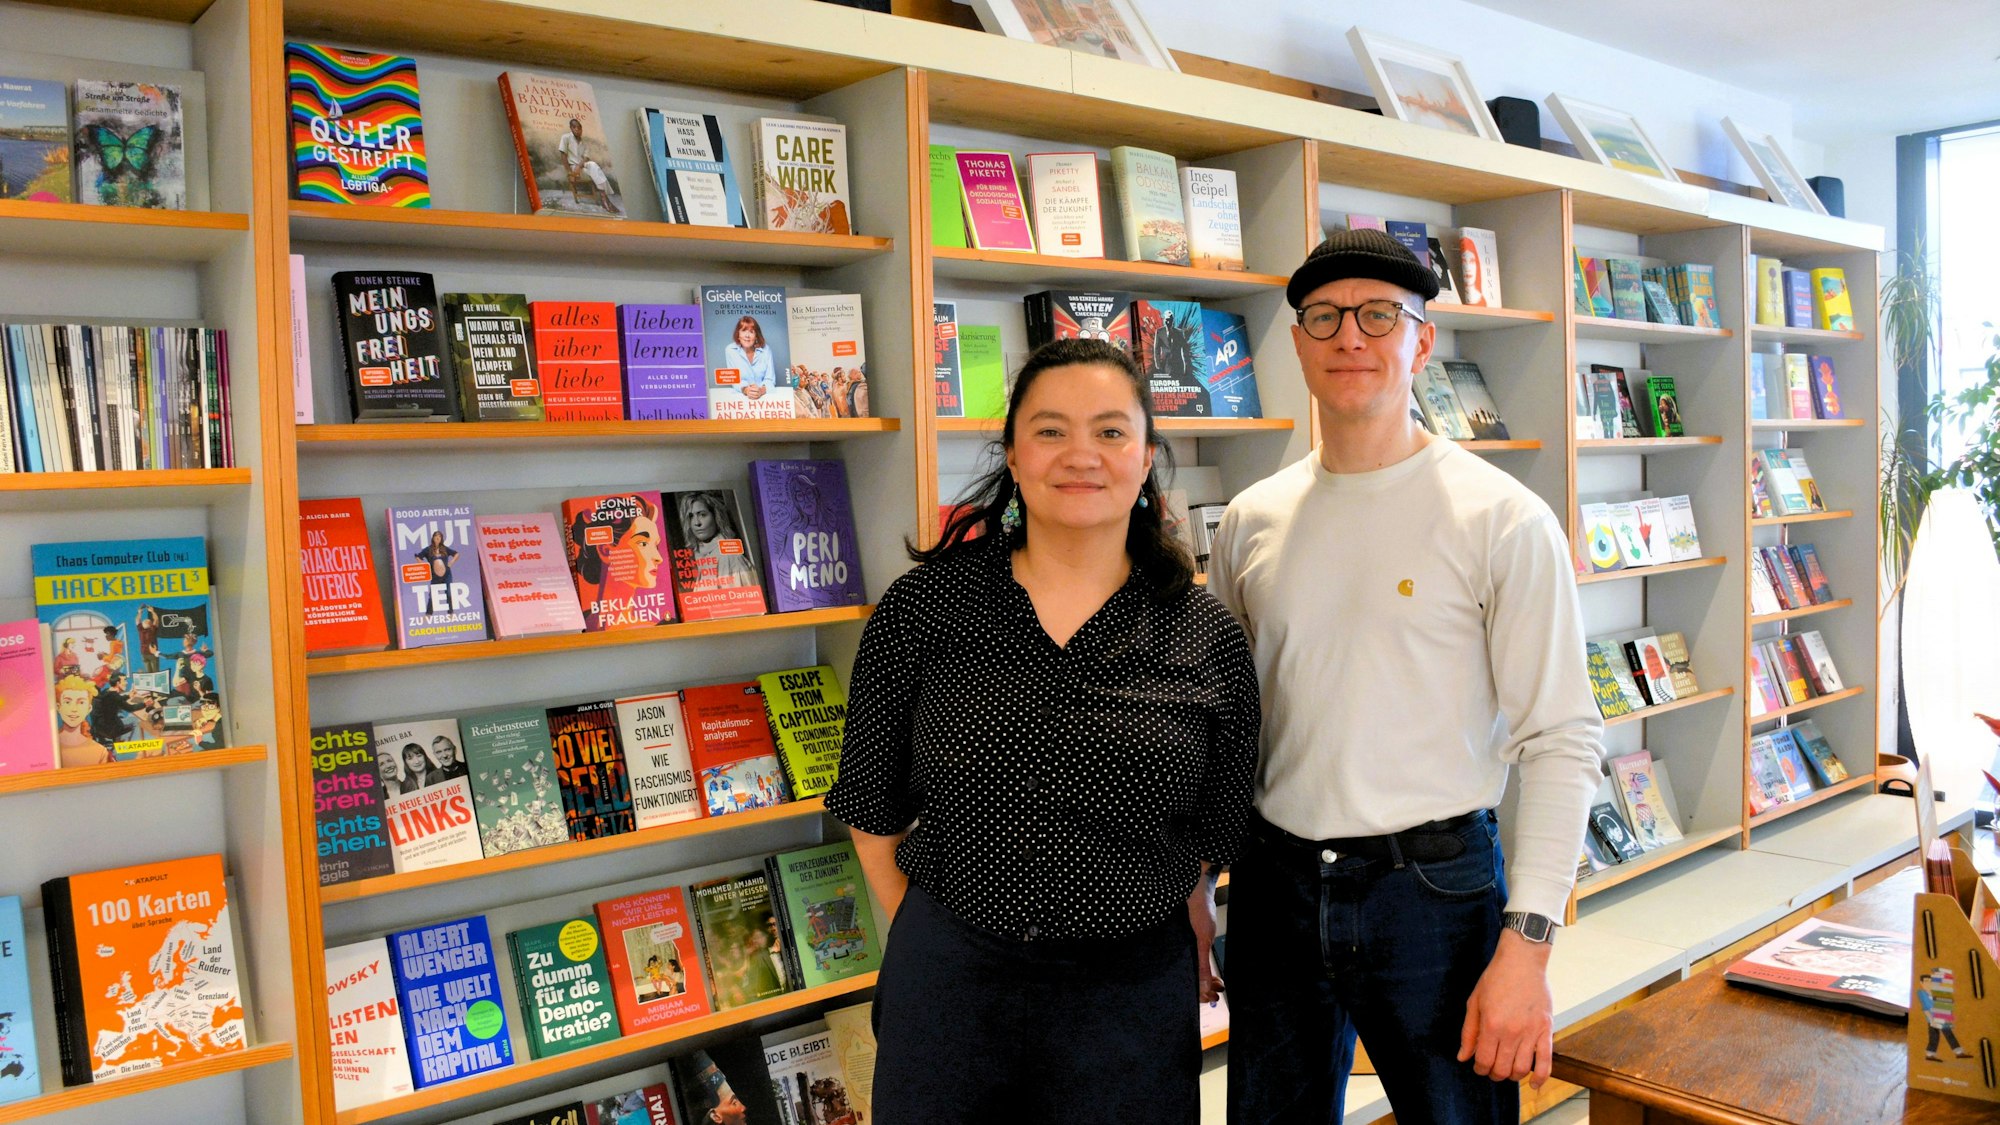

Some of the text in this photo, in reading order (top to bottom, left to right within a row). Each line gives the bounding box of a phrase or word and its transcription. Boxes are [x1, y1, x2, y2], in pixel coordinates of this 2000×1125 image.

[85, 92, 151, 104] Straße Straße
[524, 84, 566, 98] JAMES
[518, 93, 593, 112] BALDWIN
[86, 105, 168, 117] Gesammelte Gedichte
[529, 105, 586, 121] Der Zeuge
[666, 117, 700, 126] ZWISCHEN
[310, 116, 414, 152] QUEER
[678, 128, 694, 136] HASS
[677, 148, 706, 157] HALTUNG
[776, 134, 834, 164] CARE
[313, 146, 413, 170] GESTREIFT
[964, 160, 1006, 168] THOMAS
[777, 166, 836, 194] WORK
[969, 169, 1006, 178] PIKETTY
[1190, 170, 1214, 182] Ines
[342, 179, 394, 193] LGBTIQA+
[1136, 176, 1176, 194] ODYSSEE
[1192, 182, 1228, 198] Geipel
[1192, 198, 1237, 210] Landschaft
[1218, 211, 1238, 220] ohne
[1208, 220, 1238, 232] Zeugen
[355, 276, 420, 286] RONEN STEINKE
[706, 289, 782, 304] Gisèle Pelicot
[462, 304, 474, 312] OLE
[1069, 302, 1114, 312] FAKTEN
[550, 306, 600, 327] alles
[634, 310, 694, 330] lieben
[469, 320, 516, 332] WARUM ICH
[471, 333, 524, 344] NIEMALS FÜR
[473, 347, 516, 358] MEIN LAND
[553, 337, 602, 358] über
[634, 340, 698, 359] lernen
[476, 360, 513, 371] KÄMPFEN
[478, 373, 506, 385] WÜRDE
[554, 366, 604, 389] liebe
[716, 400, 791, 410] EINE HYMNE
[594, 496, 636, 510] LEONIE
[396, 506, 470, 518] 8000 ARTEN, ALS
[590, 508, 642, 522] SCHÖLER
[307, 530, 328, 546] DAS
[482, 525, 540, 536] Heute ist
[486, 539, 542, 550] ein guter
[793, 532, 838, 566] PERI
[56, 551, 170, 568] Chaos Computer Club
[489, 552, 542, 564] Tag, das
[674, 549, 693, 558] ICH
[676, 556, 718, 568] KÄMPFE
[678, 568, 719, 579] FÜR DIE
[790, 562, 848, 591] MENO
[306, 572, 362, 601] UTERUS
[497, 580, 532, 590] abzu-
[411, 582, 472, 614] TER
[501, 592, 558, 604] schaffen
[590, 592, 666, 614] BEKLAUTE
[684, 590, 760, 605] Caroline Darian
[308, 610, 356, 618] KÖRPERLICHE
[312, 604, 347, 612] PLÄDOYER
[409, 611, 481, 626] ZU VERSAGEN
[598, 608, 660, 628] FRAUEN
[409, 622, 483, 637] CAROLIN KEBEKUS
[778, 670, 824, 692] ESCAPE
[790, 688, 825, 708] FROM
[577, 704, 592, 712] JUAN
[637, 706, 666, 722] JASON
[472, 719, 540, 736] Reichensteuer
[701, 718, 754, 730] Kapitalismus-
[376, 730, 413, 747] DANIEL BAX
[635, 724, 674, 742] STANLEY
[704, 730, 738, 742] analysen
[652, 753, 670, 768] WIE
[805, 762, 835, 774] LIBERATING
[634, 769, 692, 792] FASCHISMUS
[399, 784, 462, 812] NEUE LUST AUF
[635, 788, 699, 812] FUNKTIONIERT
[387, 796, 472, 847] LINKS
[788, 852, 850, 873] WERKZEUGKASTEN
[800, 864, 844, 882] DER ZUKUNFT
[696, 876, 765, 898] MOHAMED AMJAHID
[714, 884, 768, 902] UNTER WEISSEN
[88, 890, 212, 928] 100 Karten
[612, 901, 632, 911] DAS
[624, 903, 663, 916] WIR UNS
[132, 916, 172, 929] über Sprache
[399, 922, 470, 956] ALBERT
[203, 944, 222, 954] Land
[198, 960, 232, 976] Ruderer
[402, 942, 488, 981] WENGER
[527, 952, 554, 970] Zu
[532, 962, 592, 988] dumm
[198, 992, 229, 1001] Grenzland
[408, 973, 492, 1012] DIE WELT
[535, 978, 600, 1007] für die
[126, 1008, 142, 1019] Land
[130, 1016, 140, 1024] der
[538, 1000, 603, 1025] Demo-
[128, 1022, 148, 1033] Freien
[542, 1012, 612, 1044] kratie?
[332, 1048, 396, 1057] GESELLSCHAFT
[789, 1037, 832, 1057] BLEIBT!
[121, 1062, 151, 1074] Die Inseln
[422, 1039, 502, 1083] KAPITAL
[94, 1068, 116, 1080] Westen
[334, 1073, 360, 1081] SOLLTE
